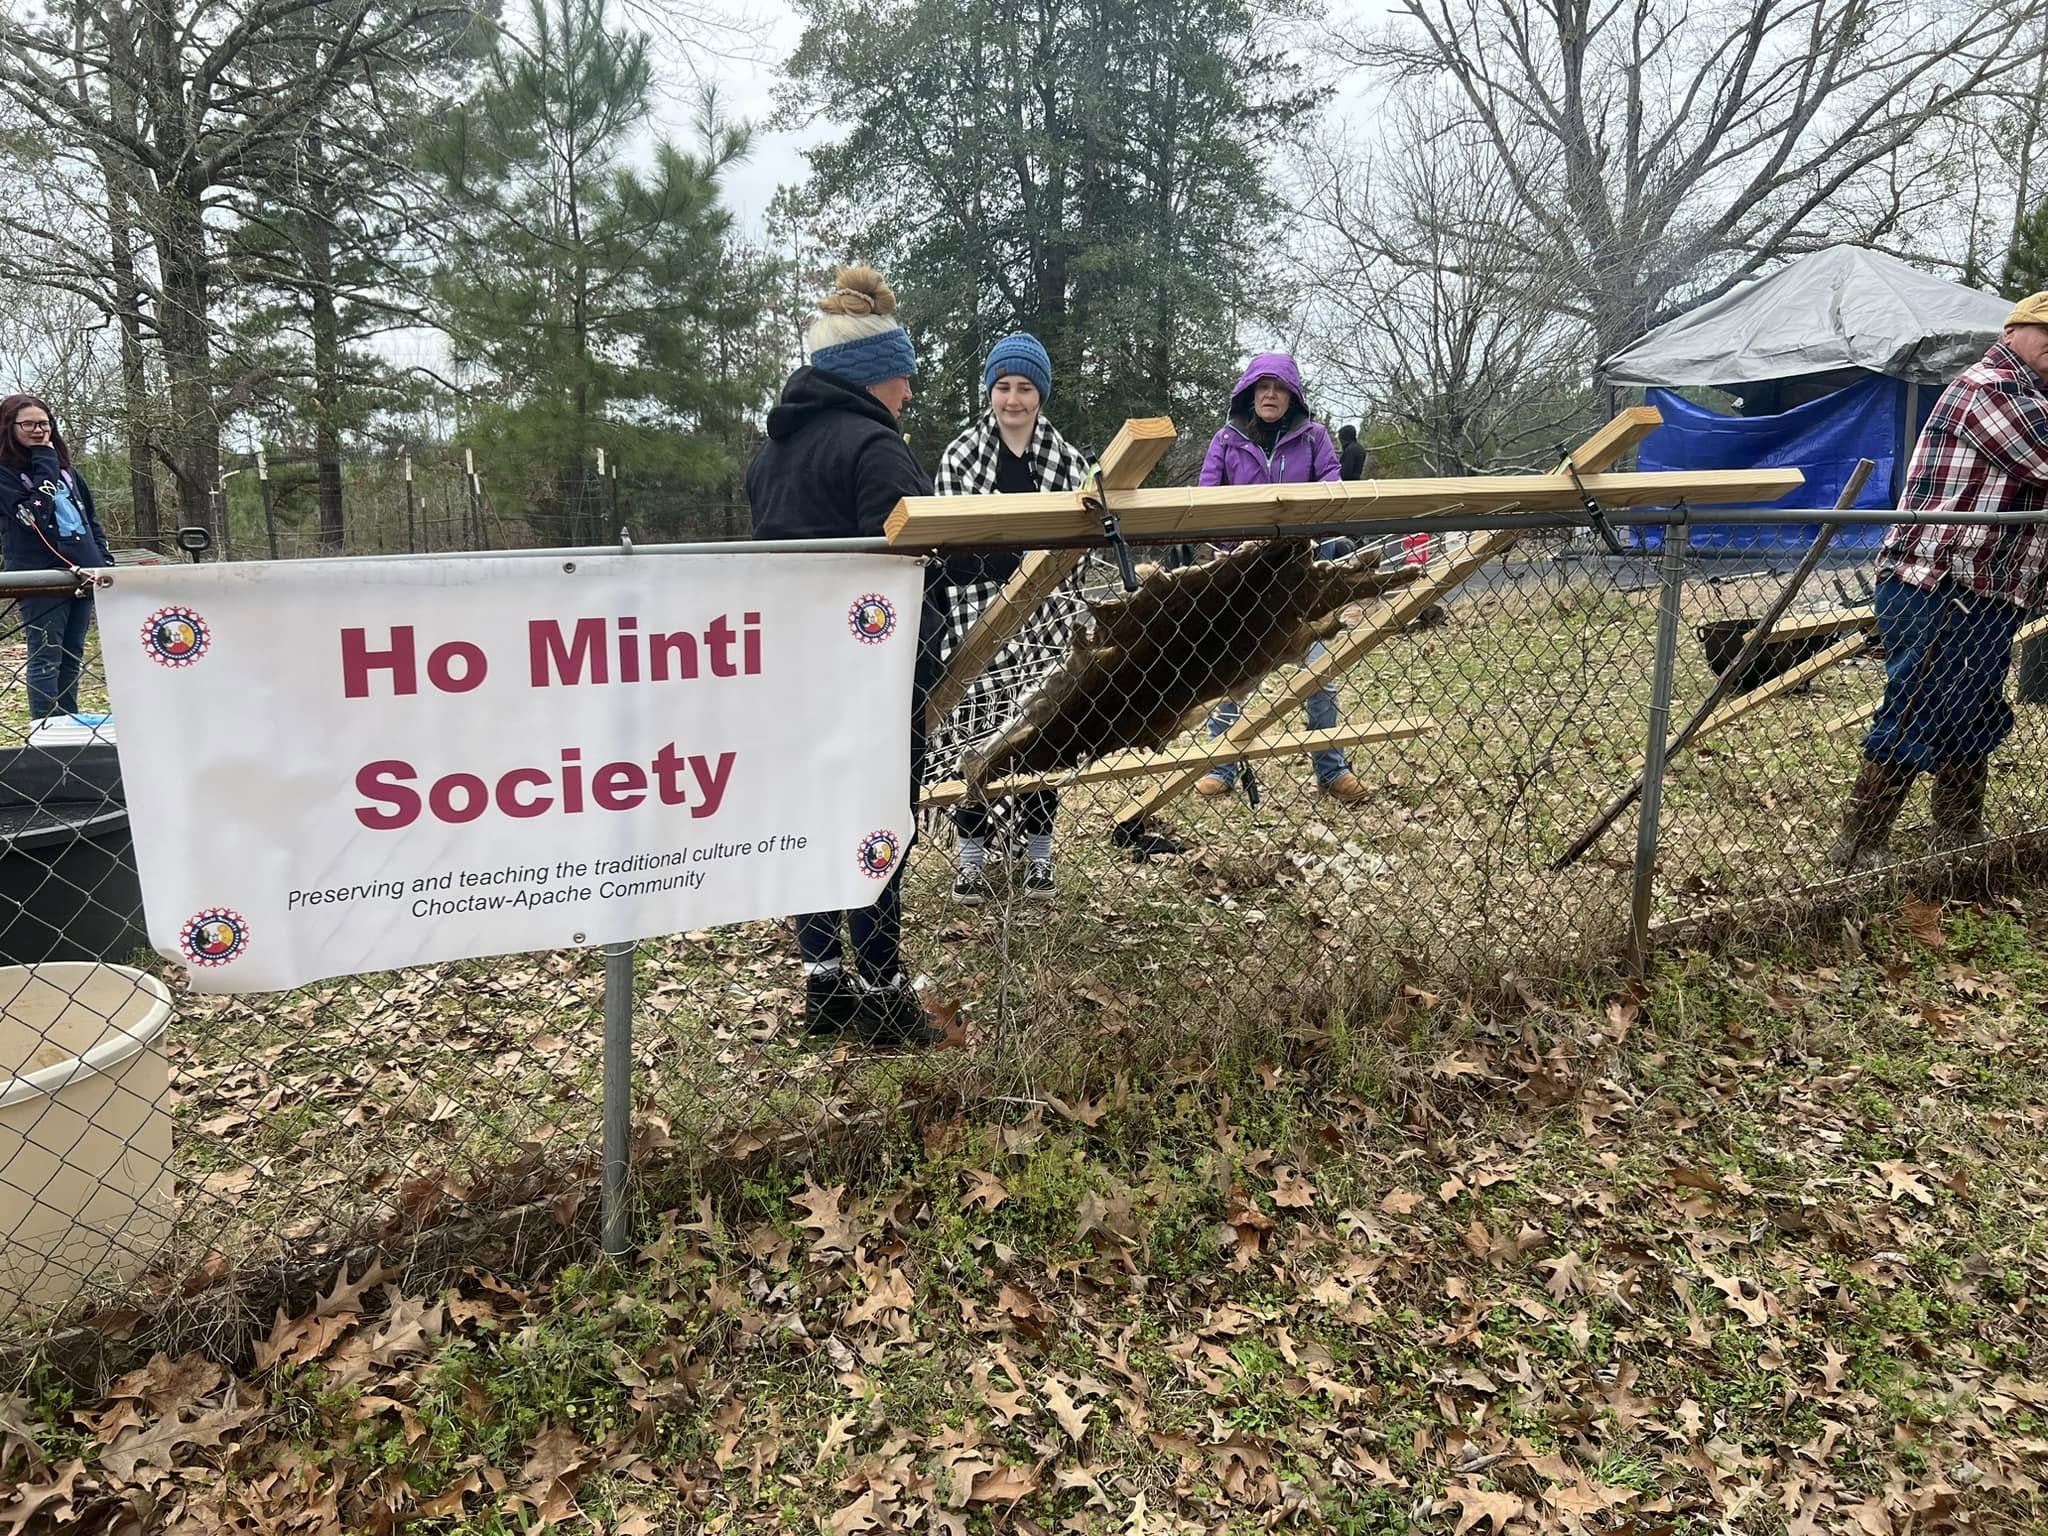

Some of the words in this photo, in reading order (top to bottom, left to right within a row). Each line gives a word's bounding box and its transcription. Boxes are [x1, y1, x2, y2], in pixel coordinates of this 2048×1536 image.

[341, 625, 488, 698] Ho
[529, 612, 762, 688] Minti
[356, 744, 737, 830] Society
[288, 880, 405, 911] Preserving
[411, 871, 453, 893] and
[459, 866, 549, 888] teaching
[556, 861, 588, 879] the
[594, 847, 688, 876] traditional
[692, 842, 752, 863] culture
[757, 835, 777, 853] of
[780, 834, 808, 851] the
[412, 885, 592, 918] Choctaw-Apache
[599, 870, 706, 900] Community
